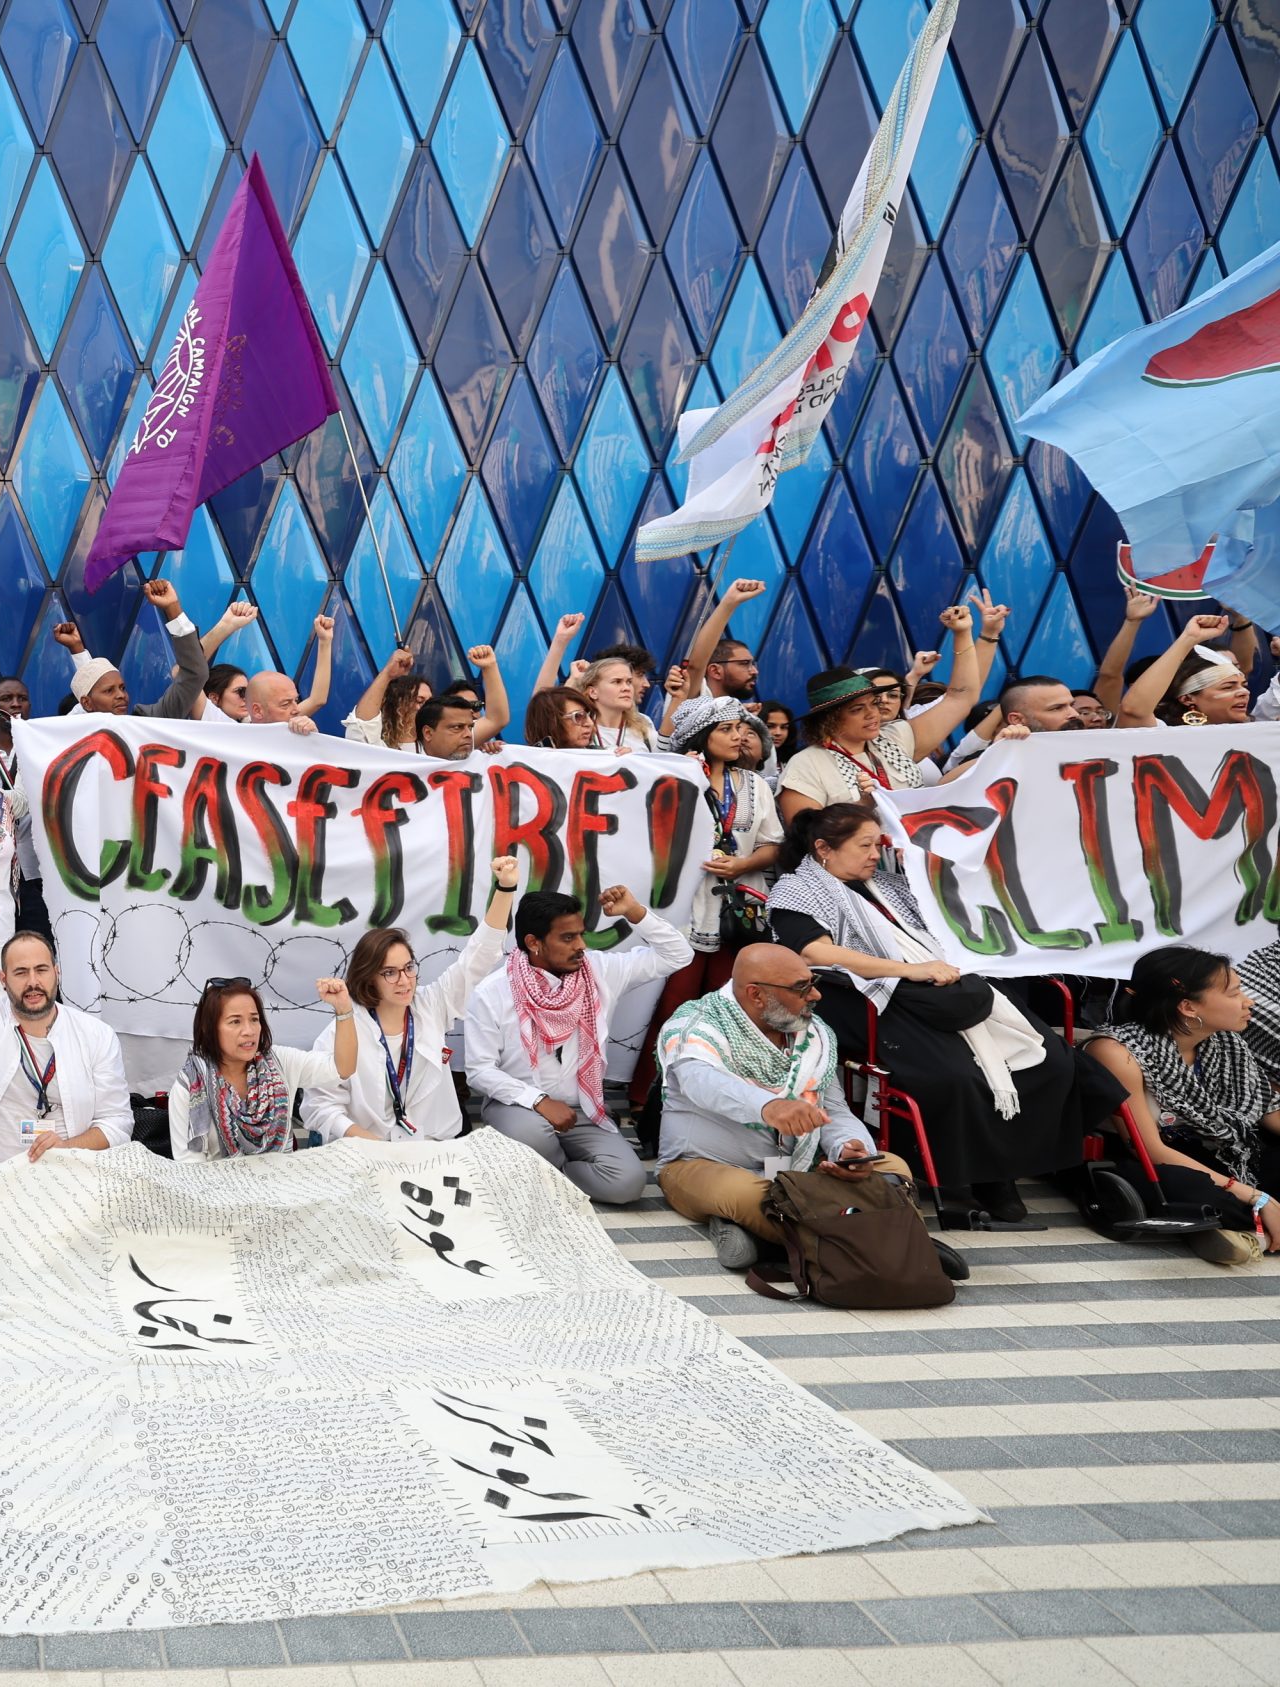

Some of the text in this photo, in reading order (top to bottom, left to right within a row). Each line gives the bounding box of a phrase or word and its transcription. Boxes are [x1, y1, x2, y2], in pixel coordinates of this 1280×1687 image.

[177, 337, 206, 418] CAMPAIGN
[156, 428, 178, 448] TO
[902, 748, 1280, 956] CLIM
